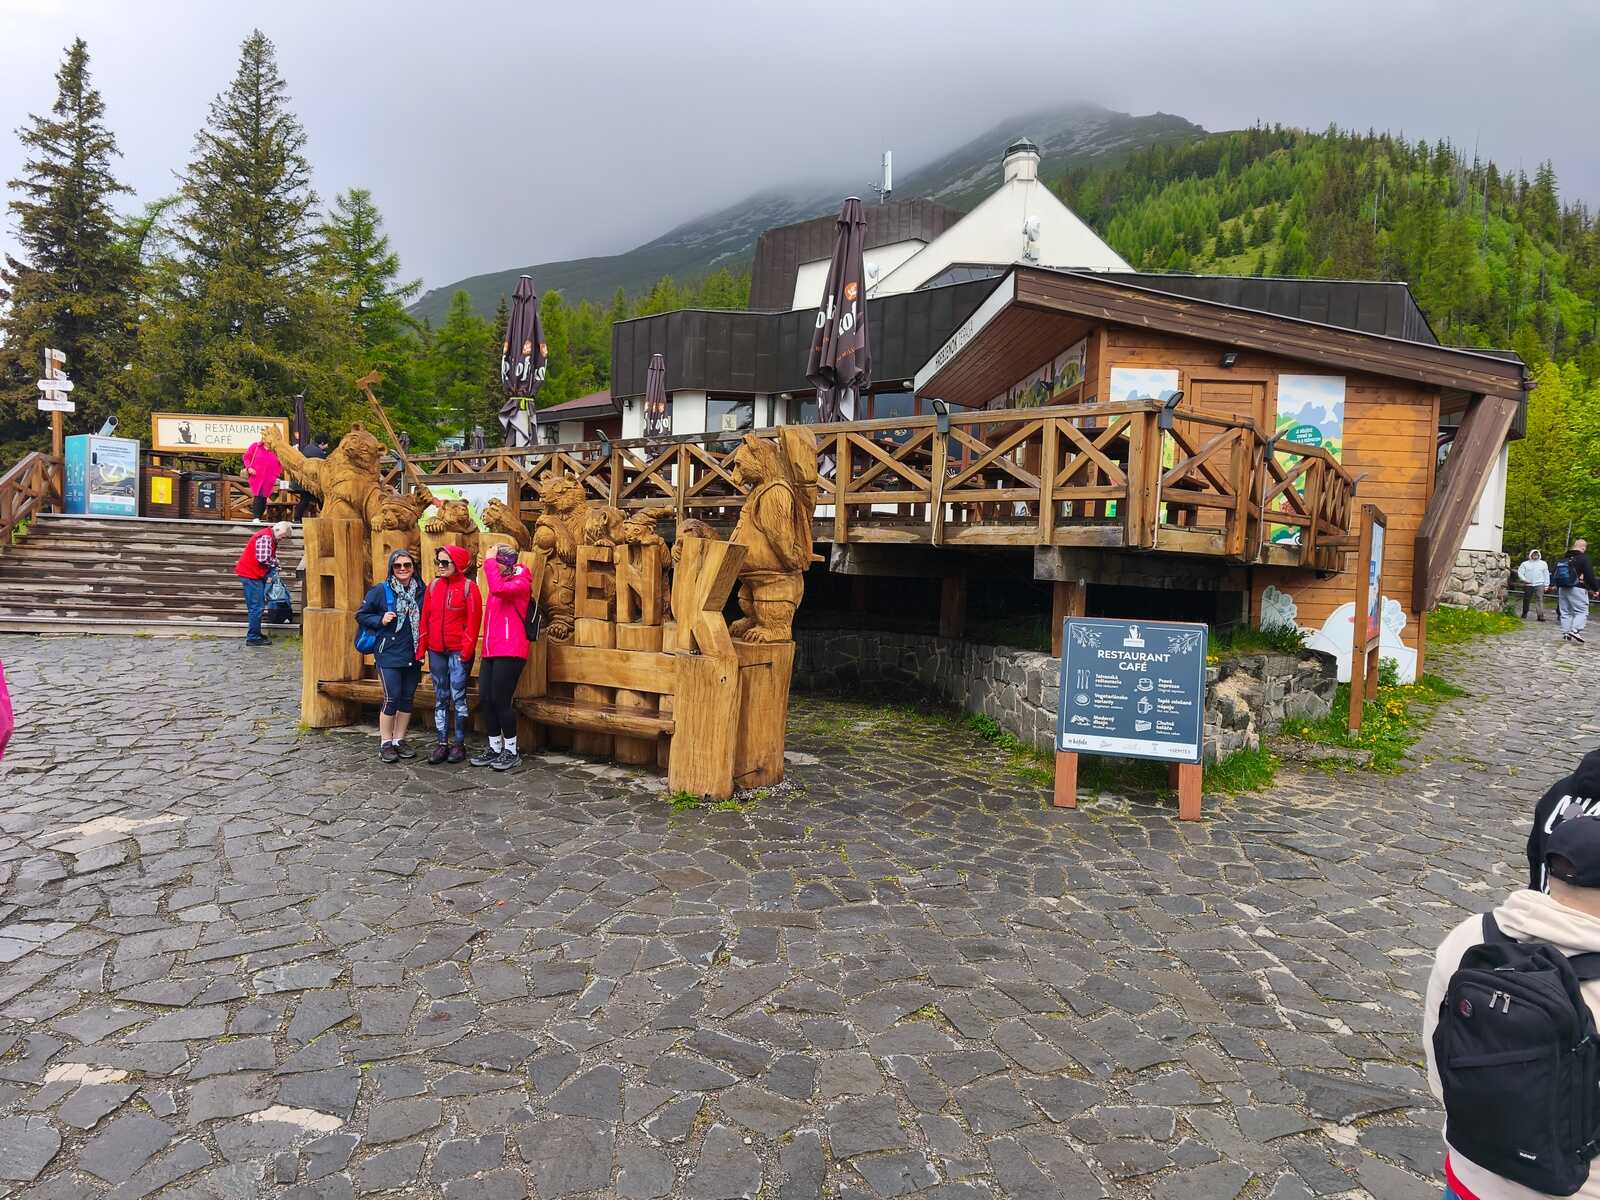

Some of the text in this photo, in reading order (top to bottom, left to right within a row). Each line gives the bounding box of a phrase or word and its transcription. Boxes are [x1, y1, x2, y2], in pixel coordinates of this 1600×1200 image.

[205, 423, 269, 434] RESTAURAN
[1097, 649, 1171, 663] RESTAURANT
[1119, 661, 1148, 672] CAFÉ
